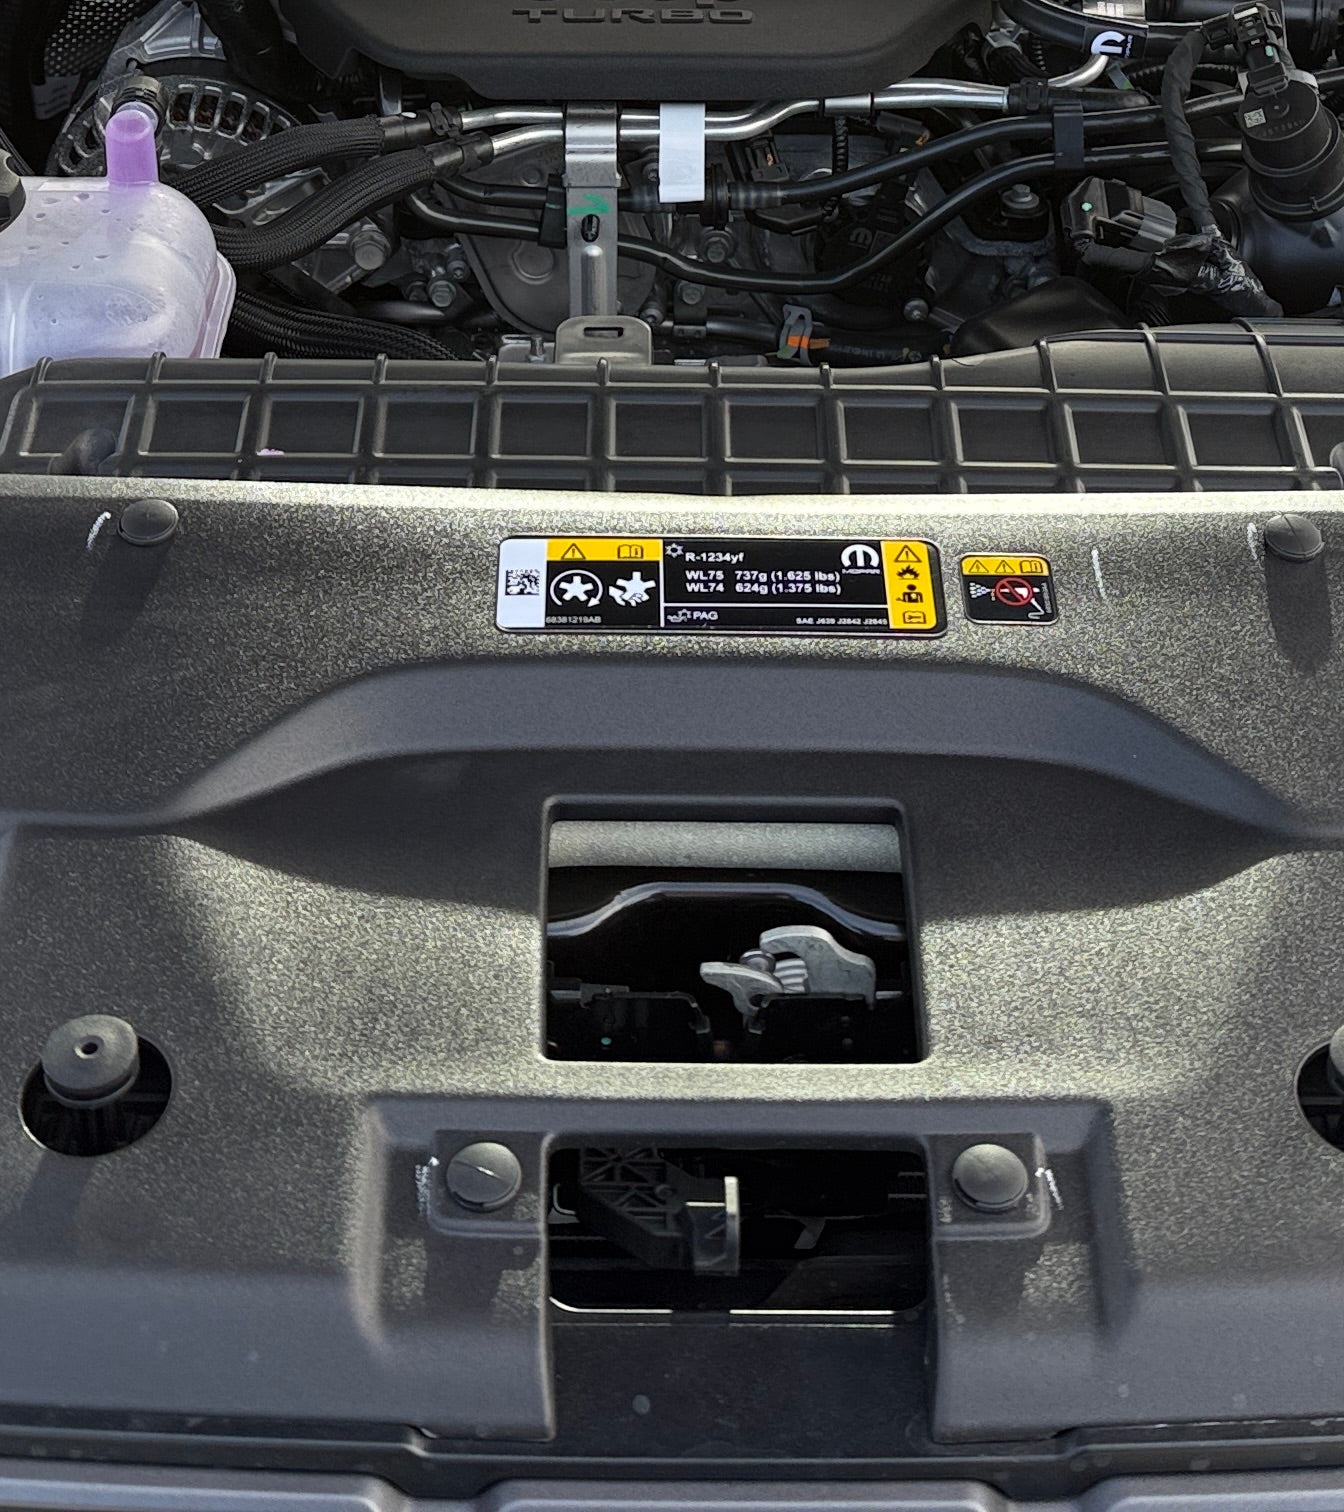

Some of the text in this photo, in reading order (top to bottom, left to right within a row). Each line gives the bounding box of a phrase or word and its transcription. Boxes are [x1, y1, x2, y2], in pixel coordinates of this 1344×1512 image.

[512, 8, 753, 24] TURBO
[685, 552, 744, 564] R-1234yf
[685, 570, 840, 583] WL75 737g (1.625 lbs)
[686, 582, 841, 595] WL74 624g (1.375 lbs)
[693, 610, 719, 621] PAG
